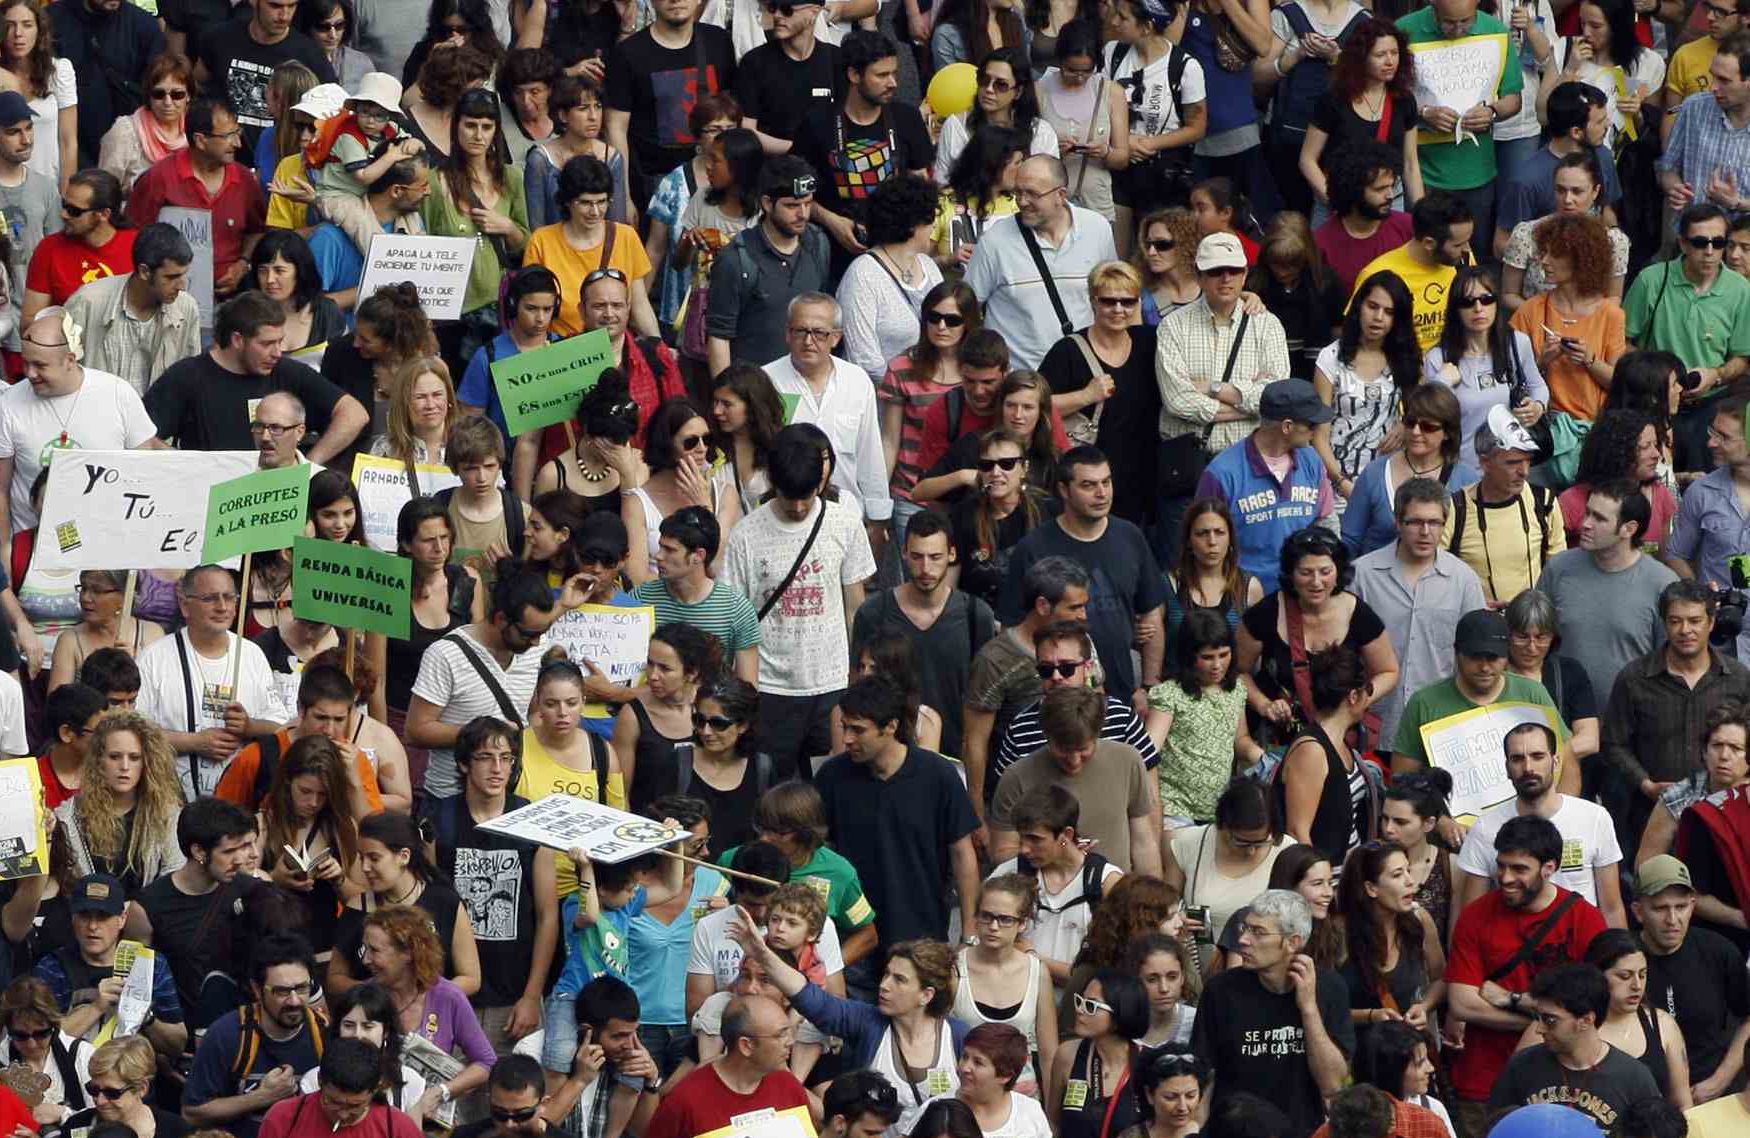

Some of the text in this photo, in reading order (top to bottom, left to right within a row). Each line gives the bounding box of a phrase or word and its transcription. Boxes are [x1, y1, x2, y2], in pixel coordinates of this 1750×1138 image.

[385, 249, 460, 260] APAGA LA TELE
[422, 262, 433, 272] TU
[507, 371, 534, 391] NO
[569, 352, 607, 371] CRISI
[517, 398, 542, 419] ÉS
[218, 486, 300, 516] CORRUPTES
[215, 504, 299, 538] A LA PRESÓ
[301, 557, 406, 591] RENDA BÁSICA
[311, 588, 394, 616] UNIVERSAL
[551, 779, 594, 800] SOS
[1244, 1030, 1261, 1042] SE
